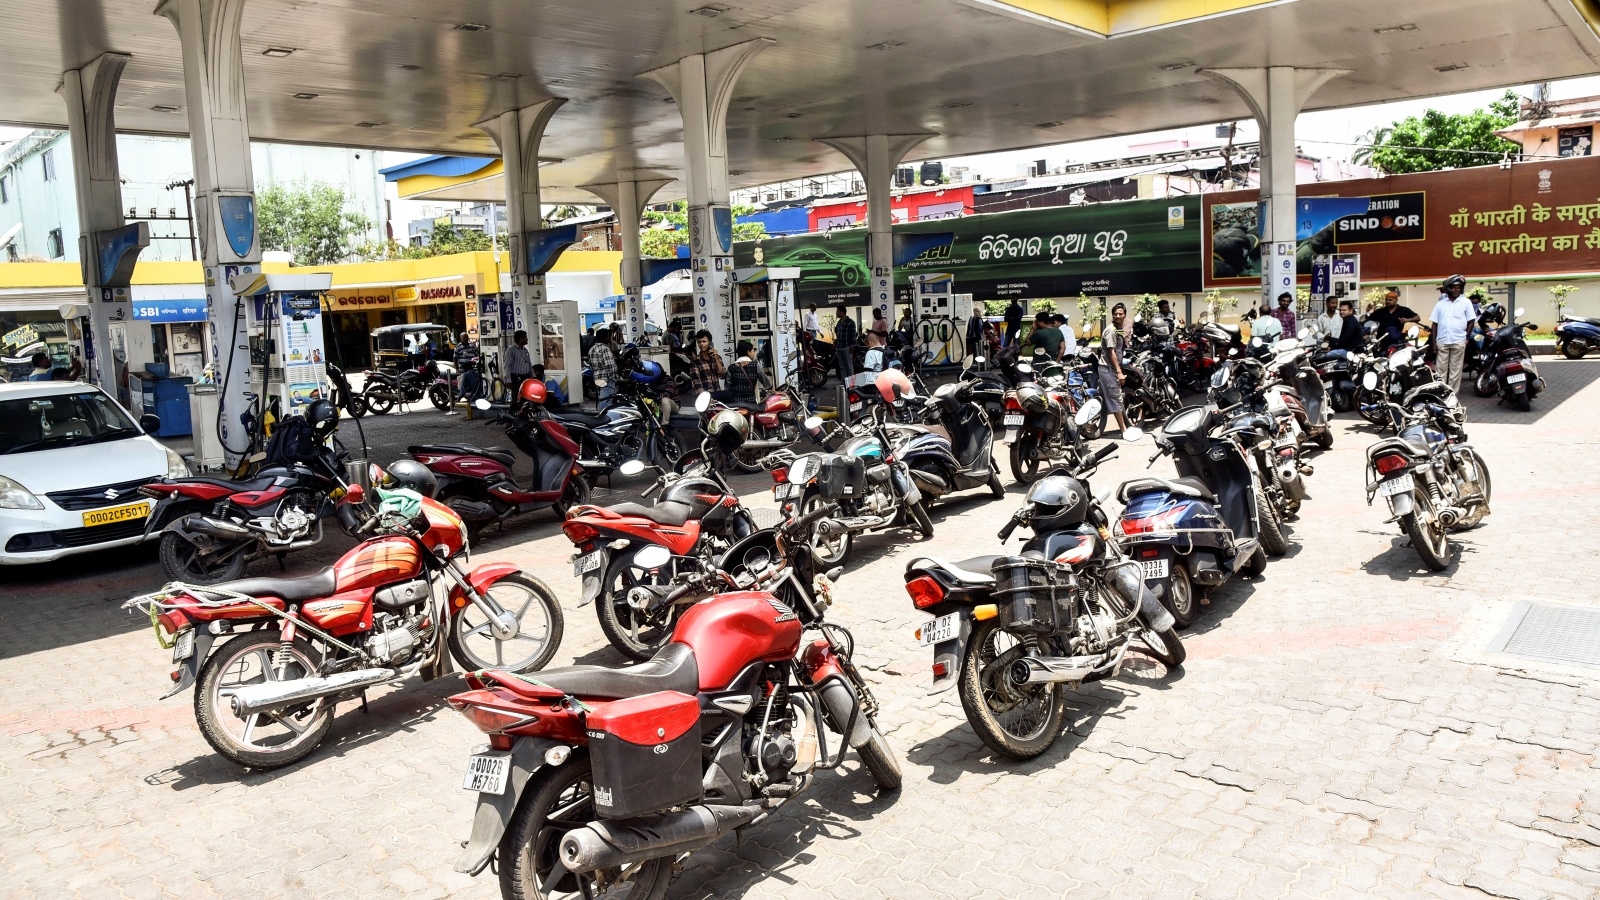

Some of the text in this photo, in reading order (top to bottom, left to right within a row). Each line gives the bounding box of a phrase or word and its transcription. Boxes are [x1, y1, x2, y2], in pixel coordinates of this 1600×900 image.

[1368, 199, 1400, 211] ERATION
[1449, 197, 1600, 228] माँ भारती के सपूत
[1302, 220, 1313, 230] 13
[1452, 241, 1475, 259] हर
[1479, 232, 1548, 255] भारतीय
[1552, 234, 1579, 251] का
[920, 259, 951, 267] Performance
[951, 257, 967, 265] Petrol
[1334, 265, 1350, 274] ATM
[420, 286, 462, 300] RASAGOLA
[140, 307, 159, 317] SBI
[486, 304, 498, 312] ATM
[505, 305, 514, 329] ATM
[5, 327, 27, 341] SHOP
[18, 334, 37, 346] FUEL
[90, 505, 149, 523] OD02CF5017
[774, 613, 799, 623] HONDA
[927, 616, 951, 633] OR 02
